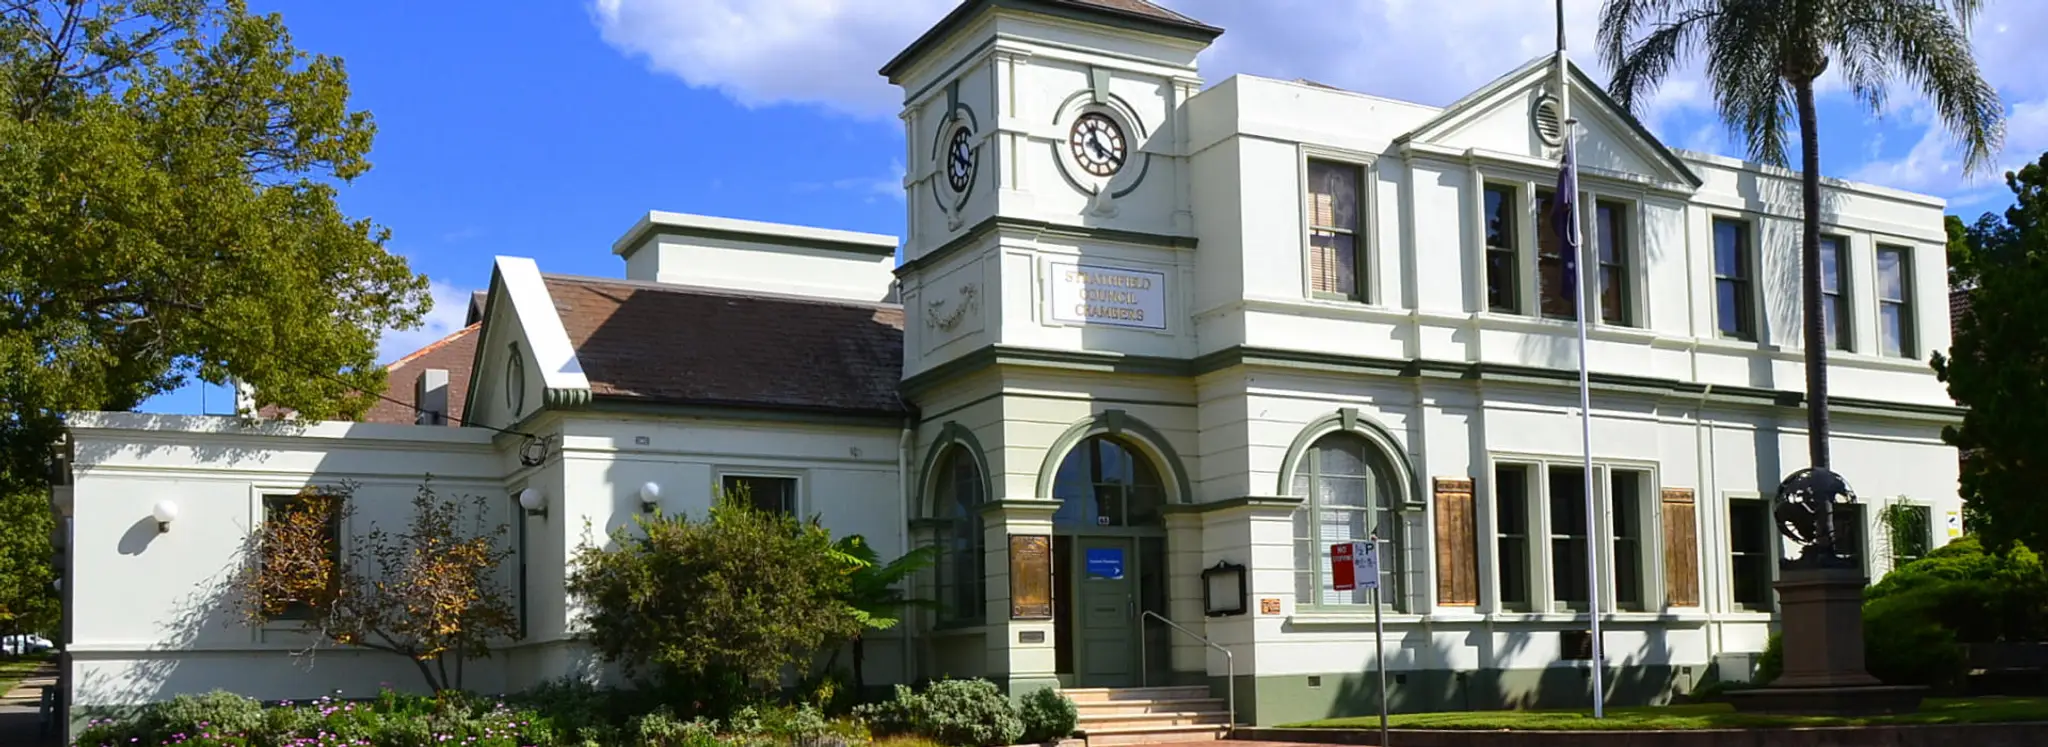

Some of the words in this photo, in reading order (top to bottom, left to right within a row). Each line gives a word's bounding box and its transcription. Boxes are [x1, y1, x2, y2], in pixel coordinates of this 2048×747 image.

[1065, 270, 1152, 291] STRATHFIELD
[1079, 288, 1138, 305] COUNCIL
[1075, 304, 1145, 322] CHAMBERS
